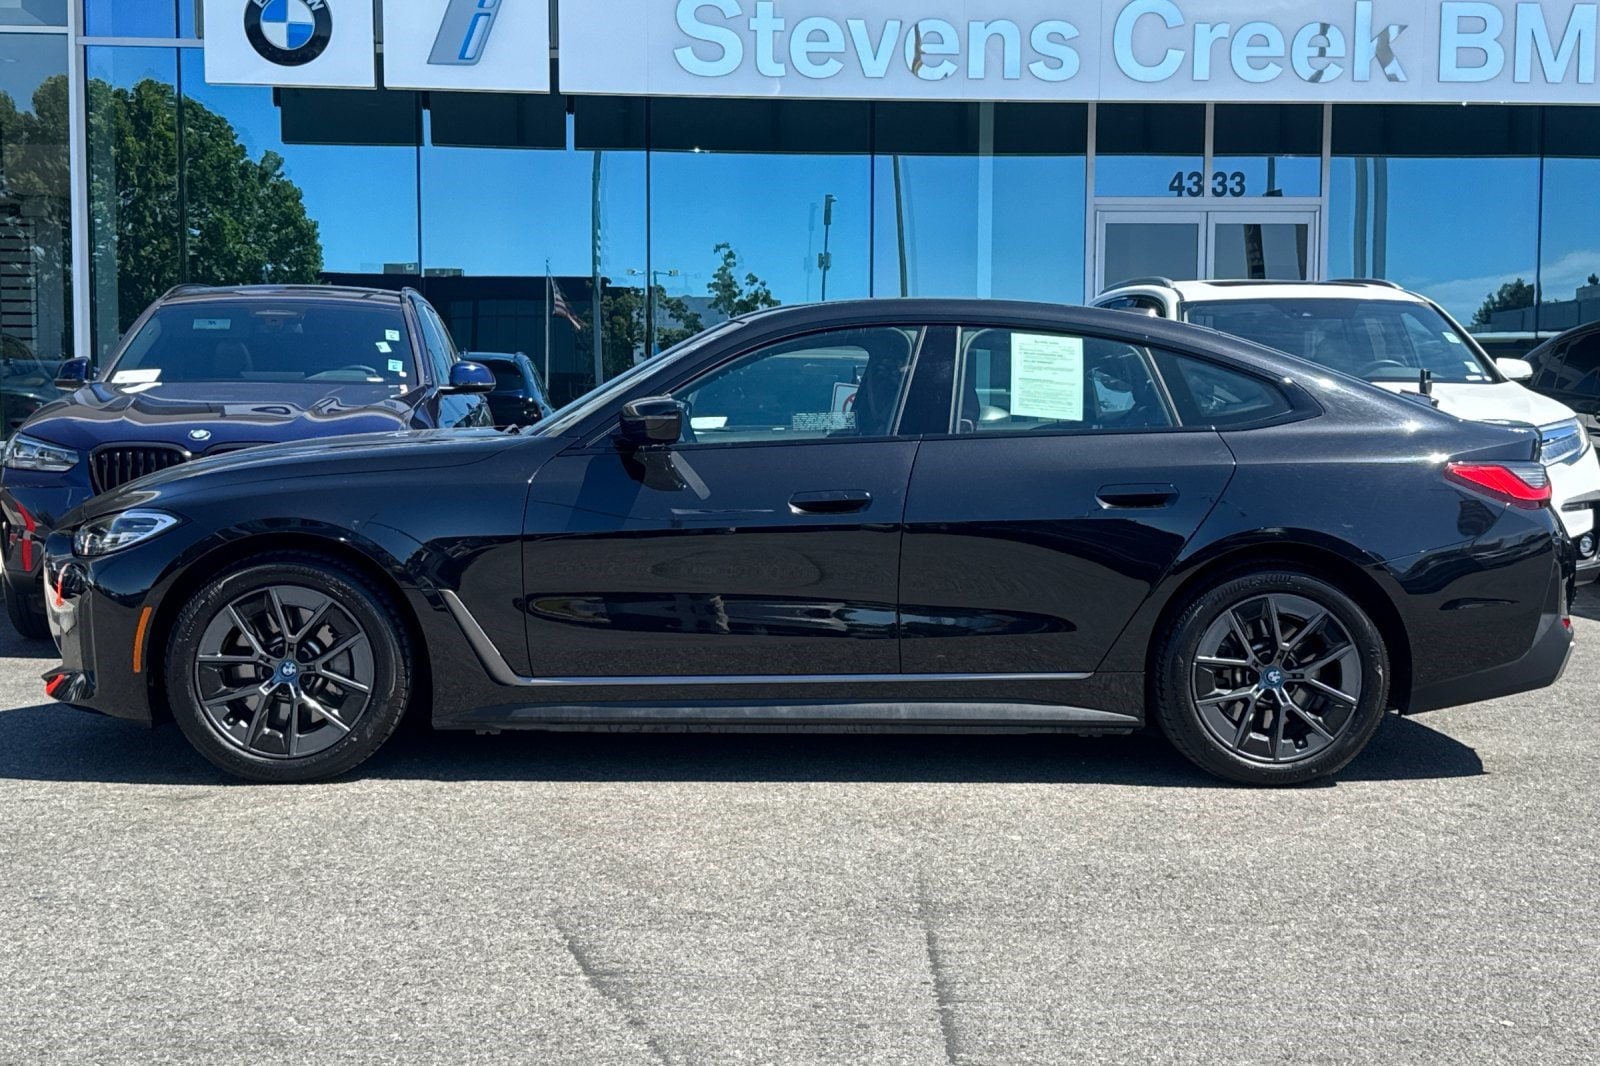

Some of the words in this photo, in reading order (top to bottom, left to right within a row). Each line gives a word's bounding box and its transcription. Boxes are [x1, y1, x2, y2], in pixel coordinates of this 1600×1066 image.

[673, 0, 1080, 82] Stevens
[1112, 0, 1409, 84] Creek
[1437, 1, 1598, 84] BM
[1168, 171, 1246, 197] 4333
